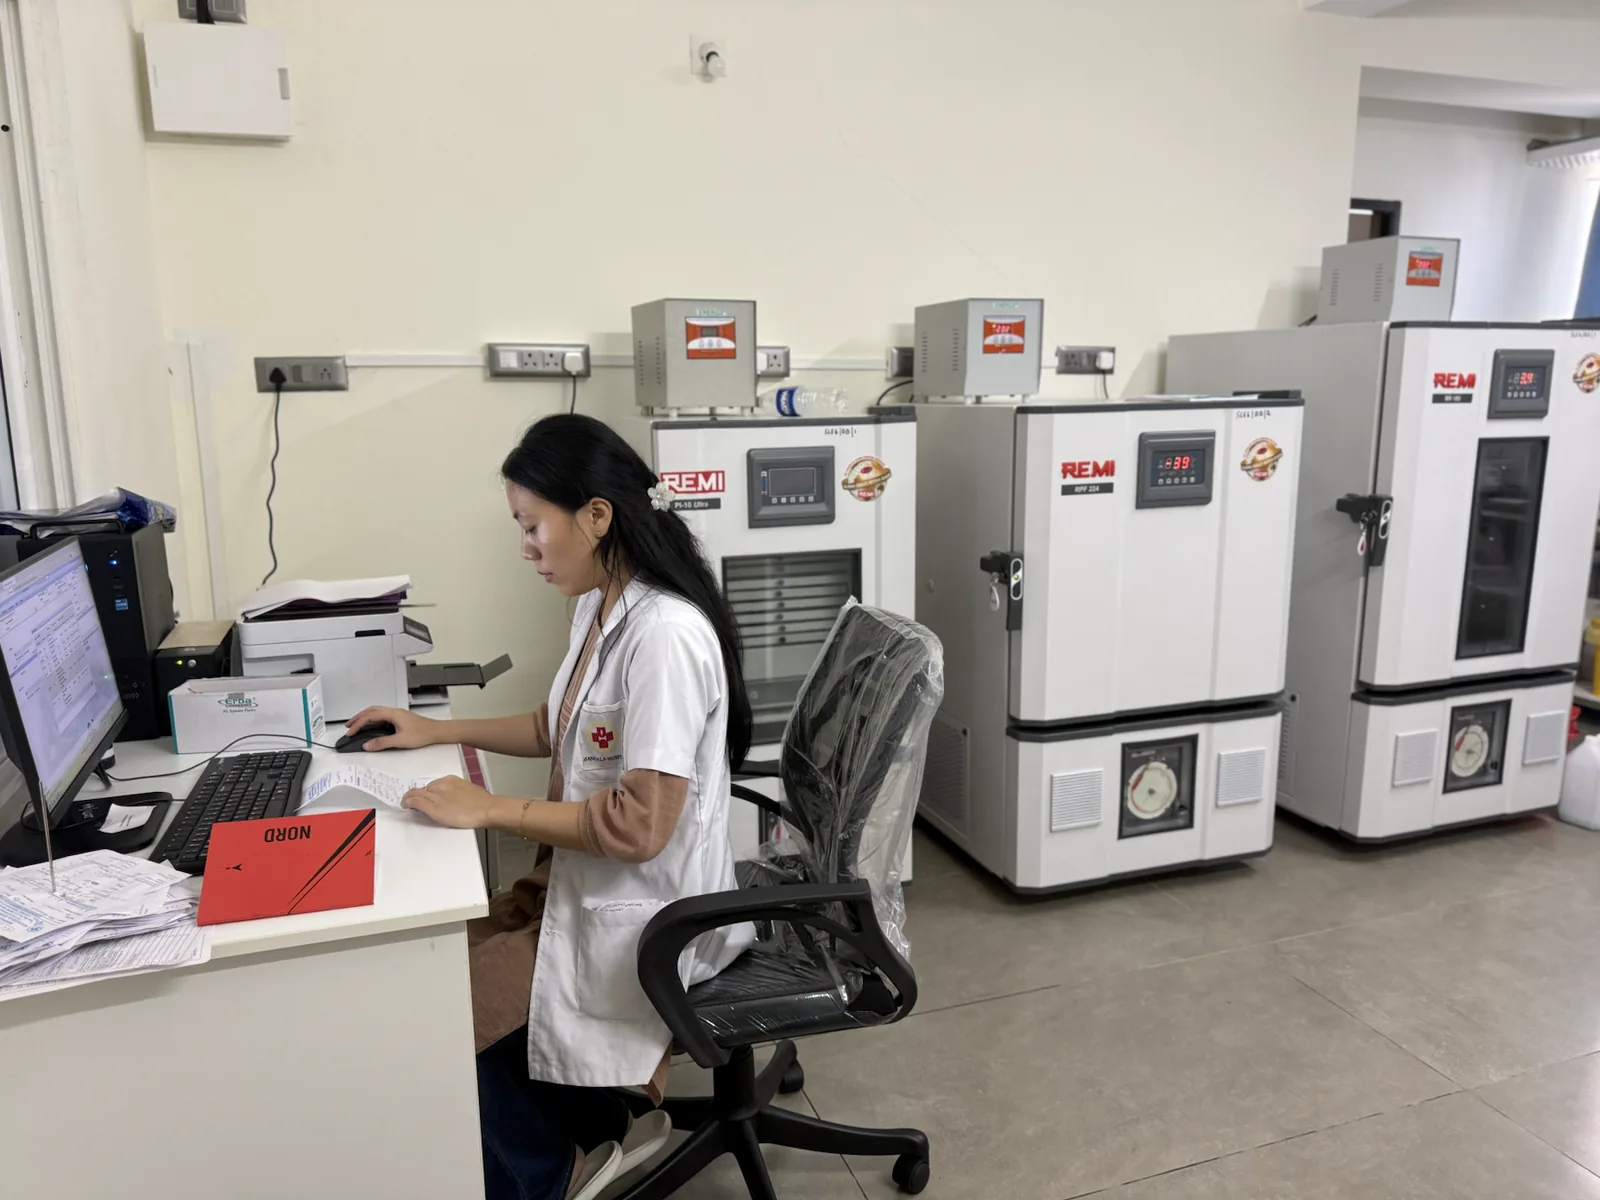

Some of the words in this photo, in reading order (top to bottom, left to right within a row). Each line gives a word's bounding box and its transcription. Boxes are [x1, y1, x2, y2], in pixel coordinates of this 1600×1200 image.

[1433, 372, 1476, 389] REMI
[1061, 460, 1115, 479] REMI
[661, 471, 724, 493] REMI
[264, 825, 311, 843] NORD
